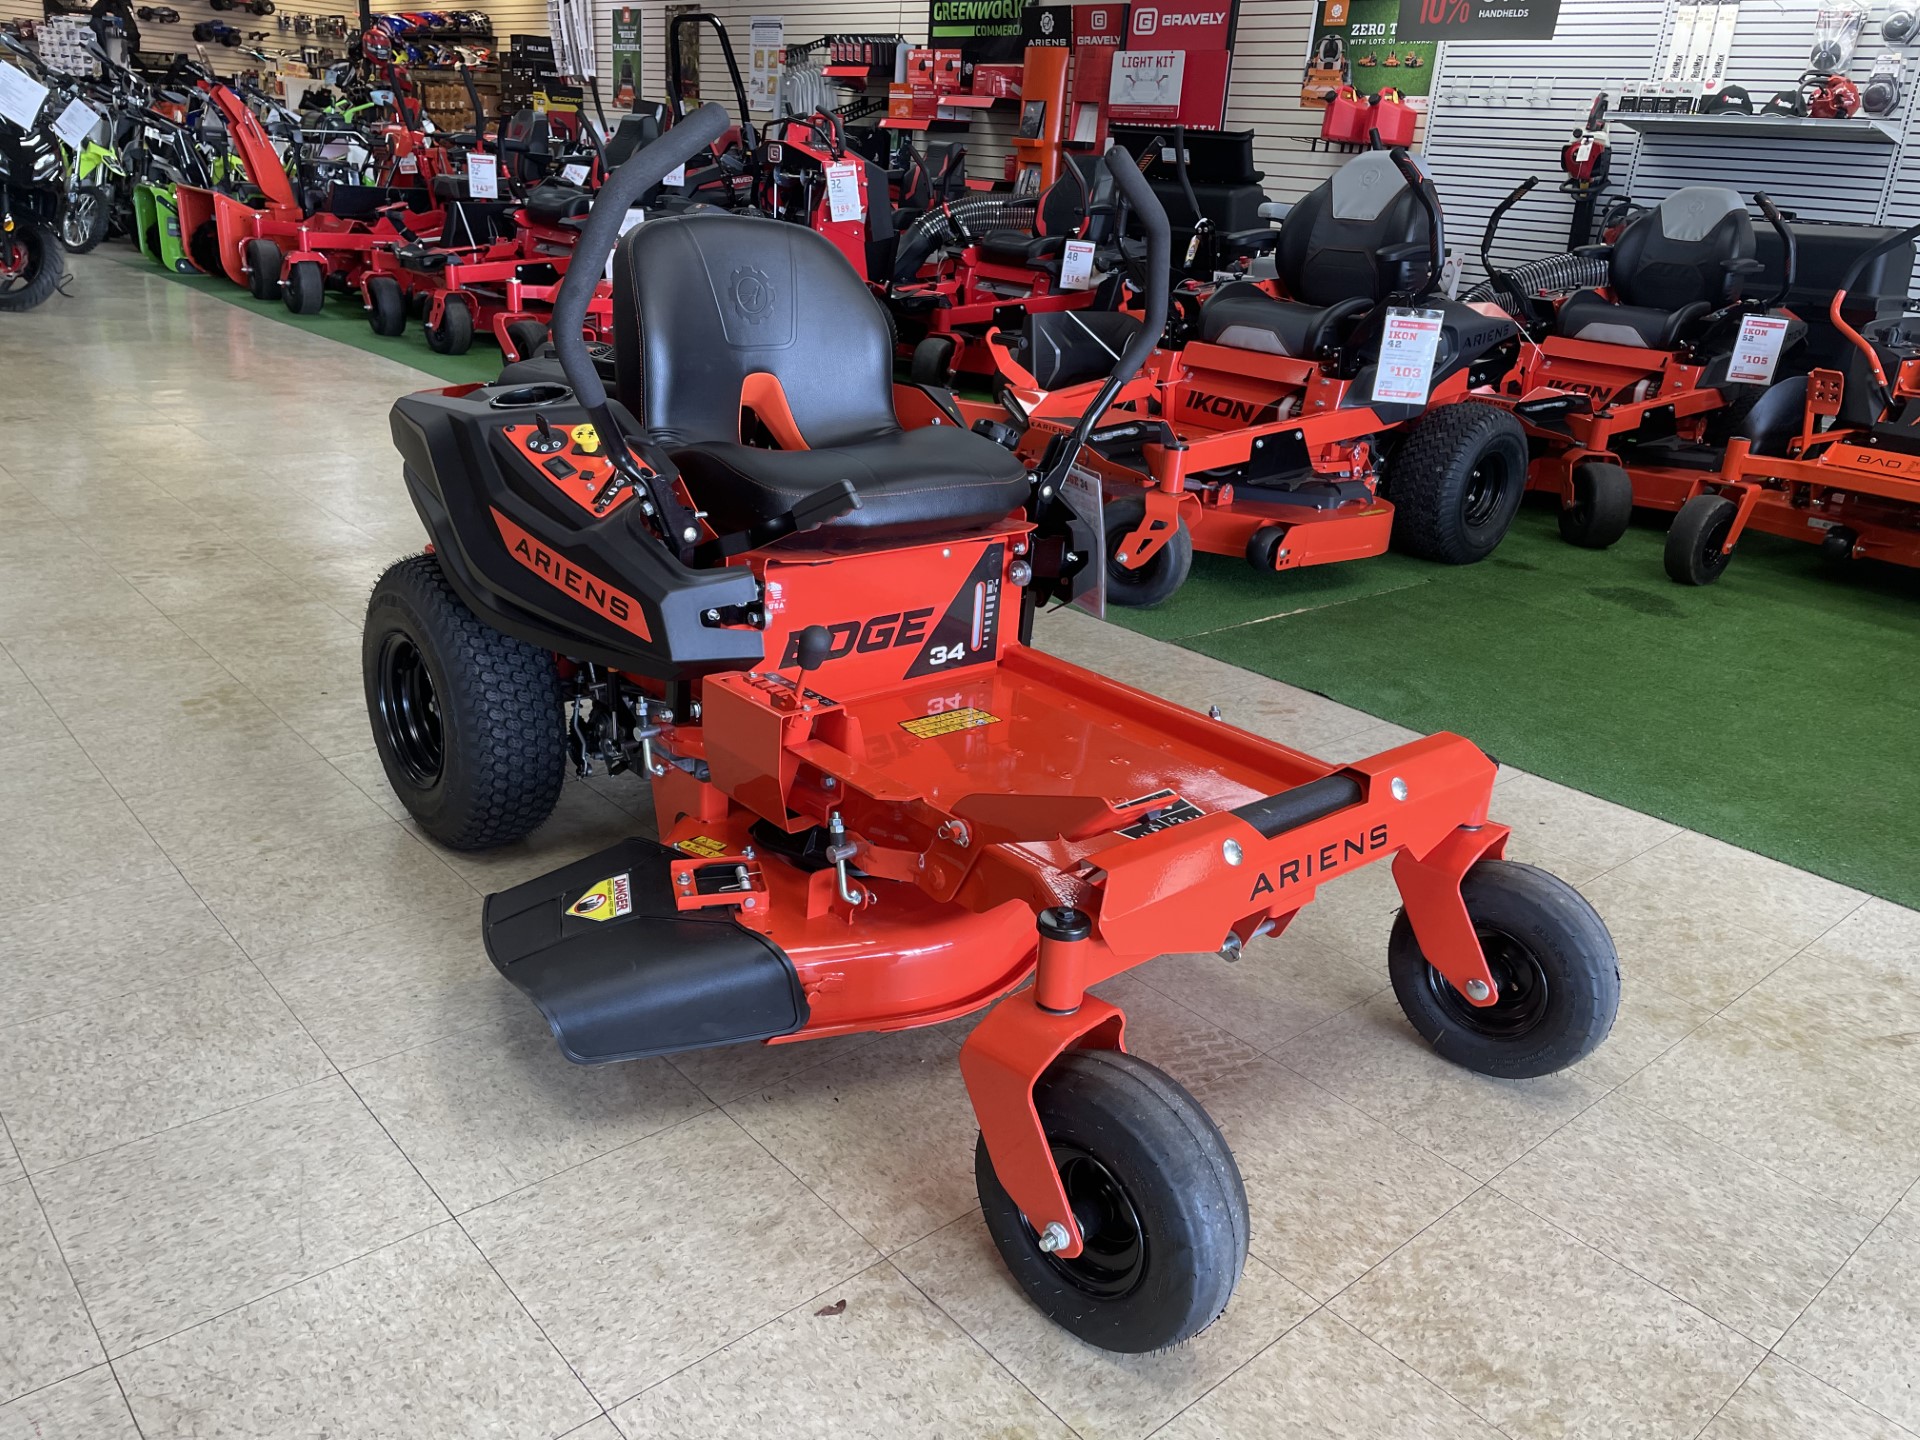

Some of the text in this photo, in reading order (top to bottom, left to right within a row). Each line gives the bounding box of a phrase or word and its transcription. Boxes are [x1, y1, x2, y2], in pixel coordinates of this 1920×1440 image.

[1420, 0, 1470, 24] 10%
[1478, 9, 1529, 18] HANDHELDS
[1161, 12, 1226, 26] GRAVELY
[1351, 23, 1386, 36] ZERO
[1028, 38, 1067, 47] ARIENS
[1077, 35, 1121, 46] GRAVELY
[526, 44, 549, 53] HELMET
[1121, 55, 1176, 68] LIGHT KIT
[1670, 54, 1684, 79] RedMax
[1690, 54, 1704, 79] RedMax
[1711, 53, 1725, 79] RedMax
[540, 70, 561, 78] HELME
[831, 179, 842, 189] 32
[1066, 251, 1079, 262] 48
[1388, 330, 1418, 341] IKON
[1463, 324, 1510, 350] ARIENS
[1742, 334, 1755, 342] 52
[1743, 328, 1769, 337] IKON
[1387, 340, 1402, 349] 42
[1390, 366, 1422, 379] $103
[1185, 390, 1256, 423] IKON
[1856, 454, 1902, 469] BAD
[1080, 478, 1089, 491] 34
[514, 537, 630, 622] ARIENS
[929, 642, 966, 665] 34
[1249, 823, 1388, 902] ARIENS
[614, 878, 629, 912] DANGER
